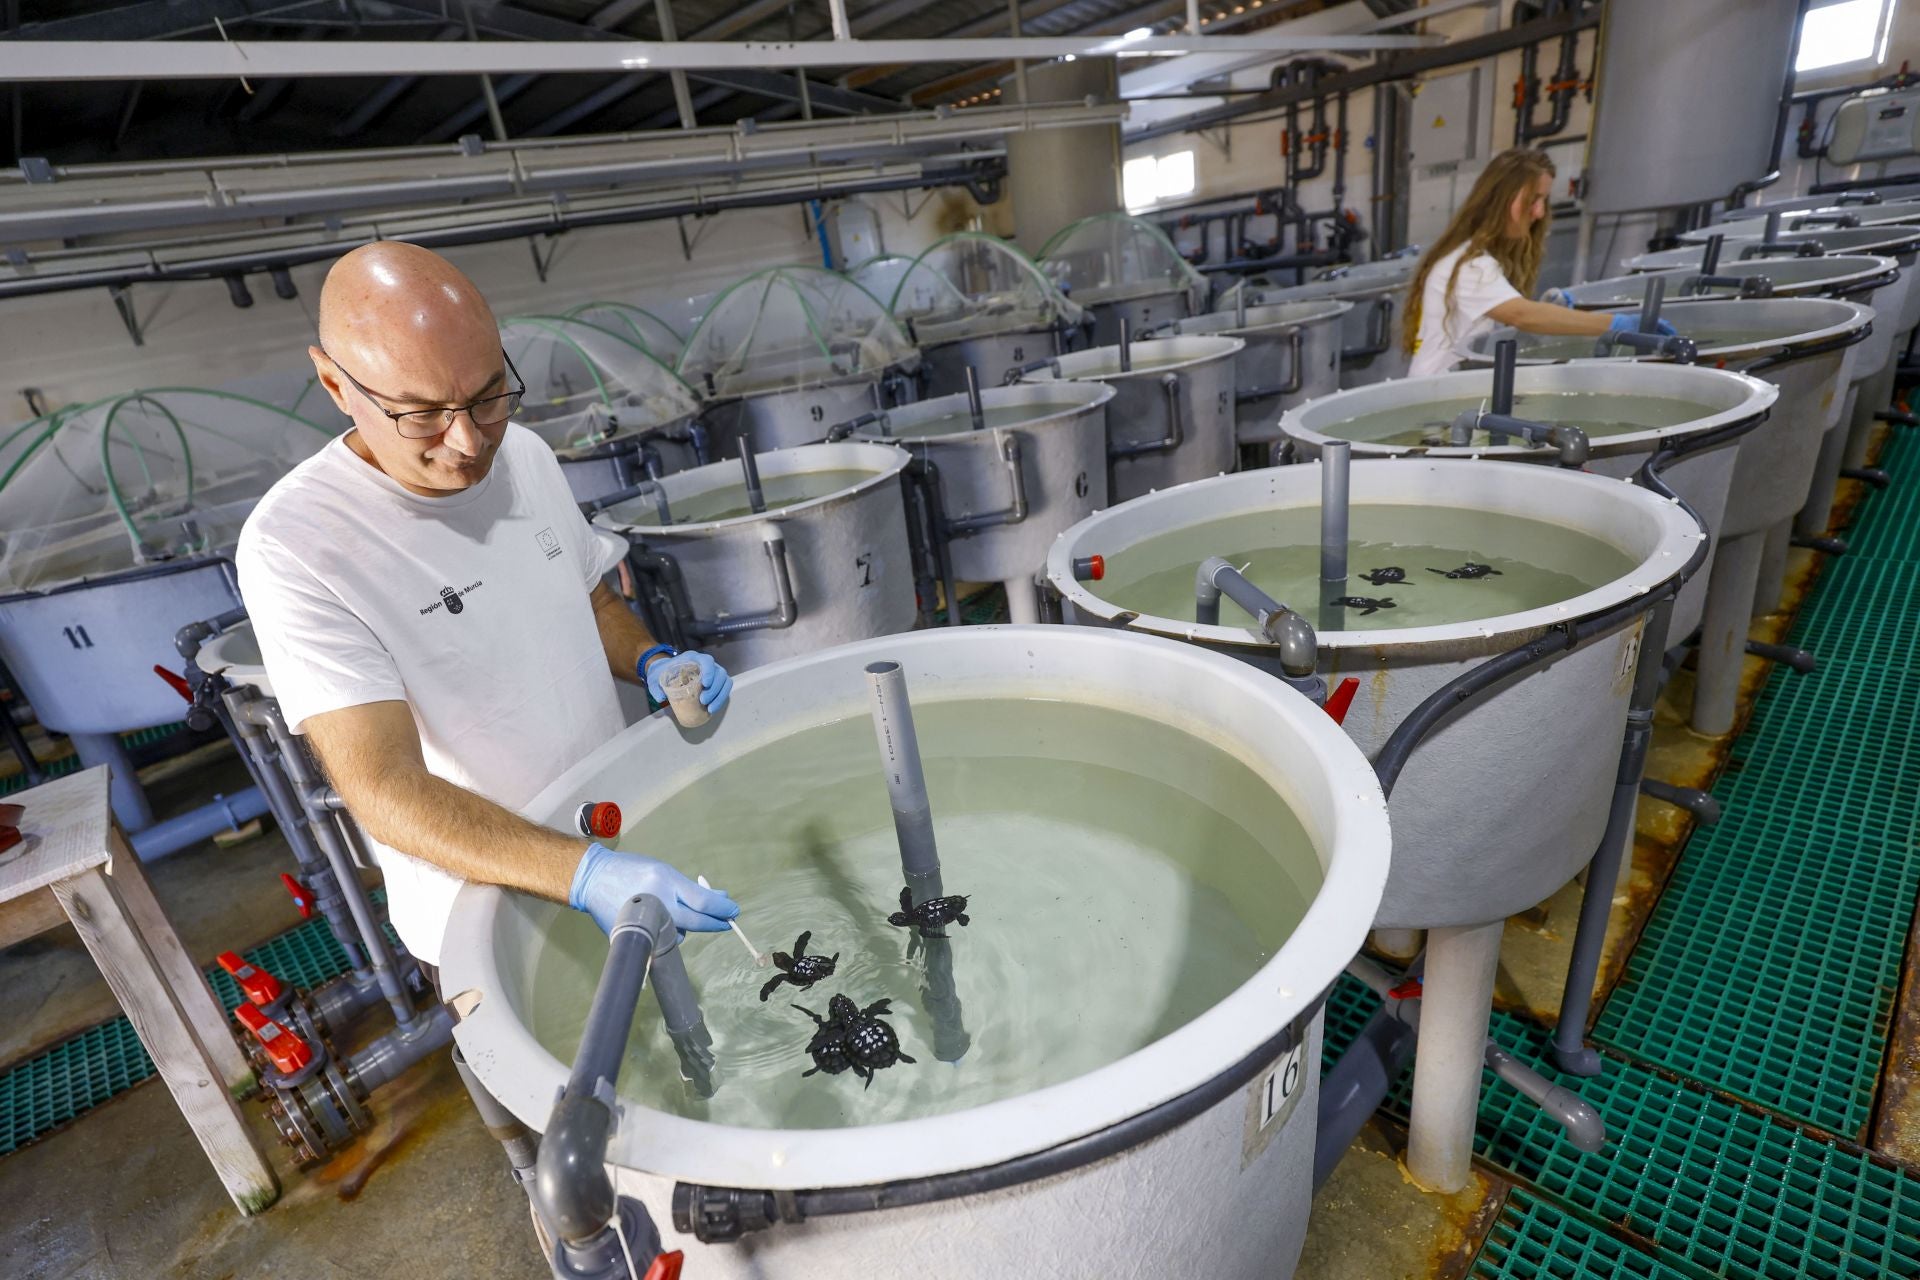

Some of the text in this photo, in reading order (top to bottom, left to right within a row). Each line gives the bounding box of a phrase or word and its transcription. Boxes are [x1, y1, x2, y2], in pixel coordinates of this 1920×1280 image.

[810, 404, 824, 422] 9
[1075, 471, 1089, 499] 6
[856, 552, 874, 588] 7
[419, 600, 443, 616] Región
[463, 580, 483, 594] Murcia
[62, 624, 95, 650] 11
[1262, 1046, 1299, 1126] 16
